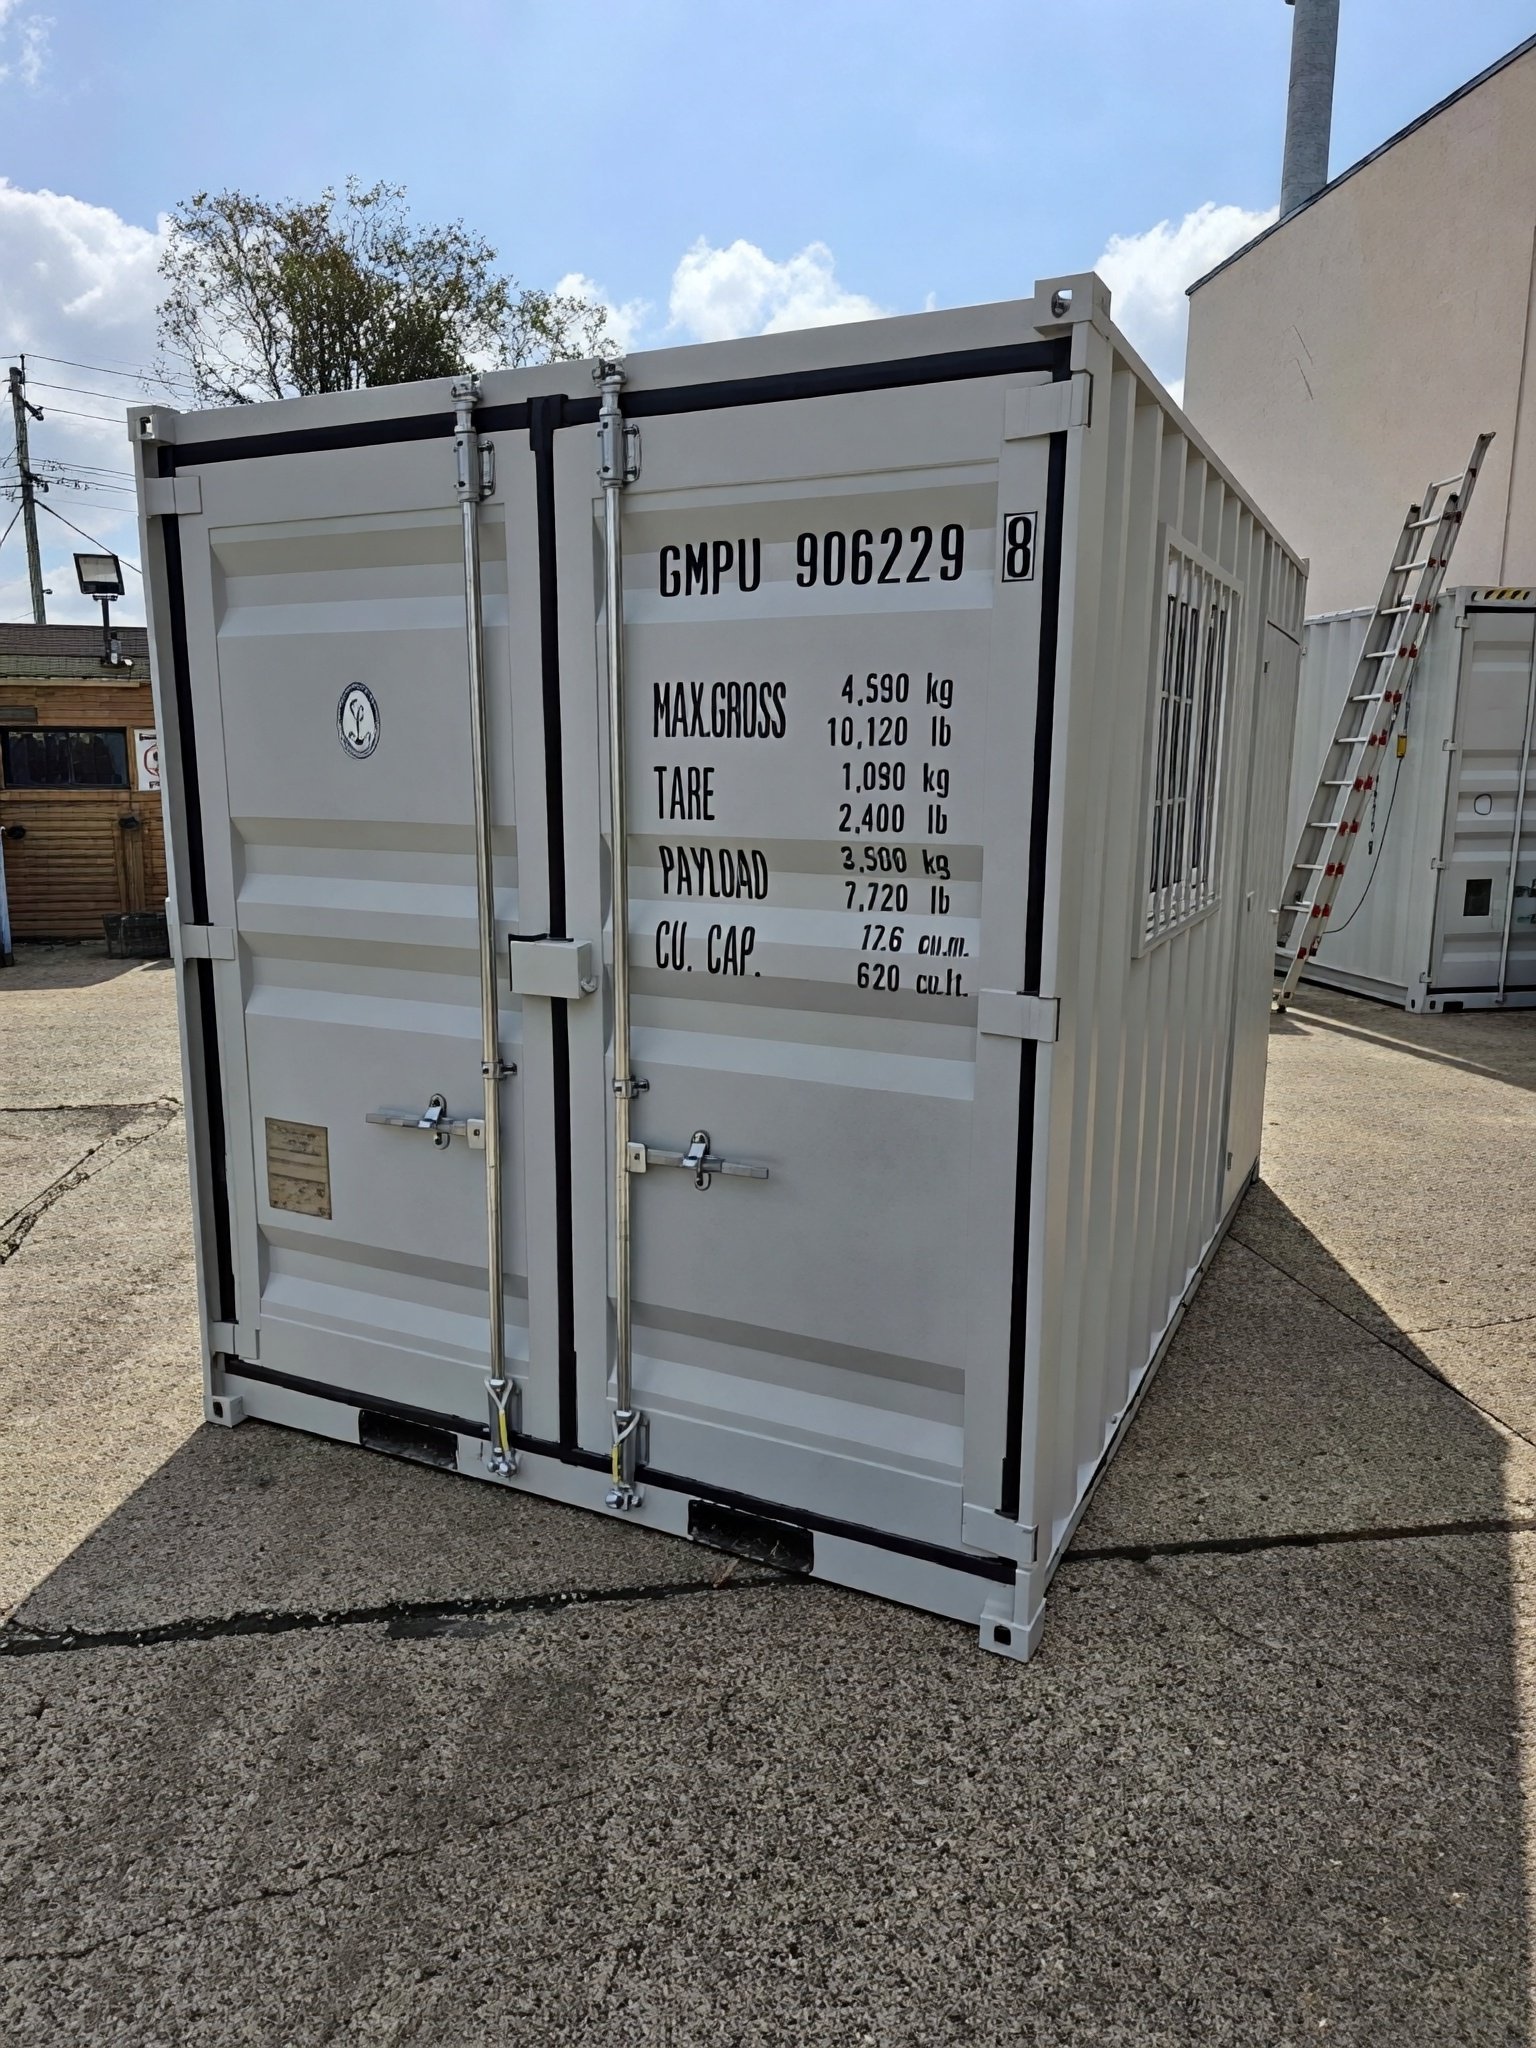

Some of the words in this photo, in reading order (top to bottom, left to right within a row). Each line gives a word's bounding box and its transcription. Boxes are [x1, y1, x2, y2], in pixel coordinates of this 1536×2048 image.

[659, 537, 761, 598] GMPU
[796, 523, 965, 588] 906229
[1006, 516, 1032, 578] 8
[653, 681, 787, 739] MAX.GROSS
[841, 672, 910, 707] 4,590
[926, 672, 954, 710] kg
[827, 715, 908, 750] 10,120
[931, 715, 952, 747] lb
[653, 765, 716, 821] TARE
[842, 761, 906, 794] 1,090
[923, 762, 950, 799] kg
[838, 802, 905, 835] 2,400
[927, 804, 948, 835] lb
[658, 845, 769, 900] PAYLOAD
[840, 845, 908, 875] 3,500
[921, 848, 951, 881] kg
[844, 880, 908, 913] 7,720
[930, 885, 951, 915] lb
[655, 920, 693, 973] CU.
[707, 924, 761, 978] CAP.
[857, 962, 900, 992] 620
